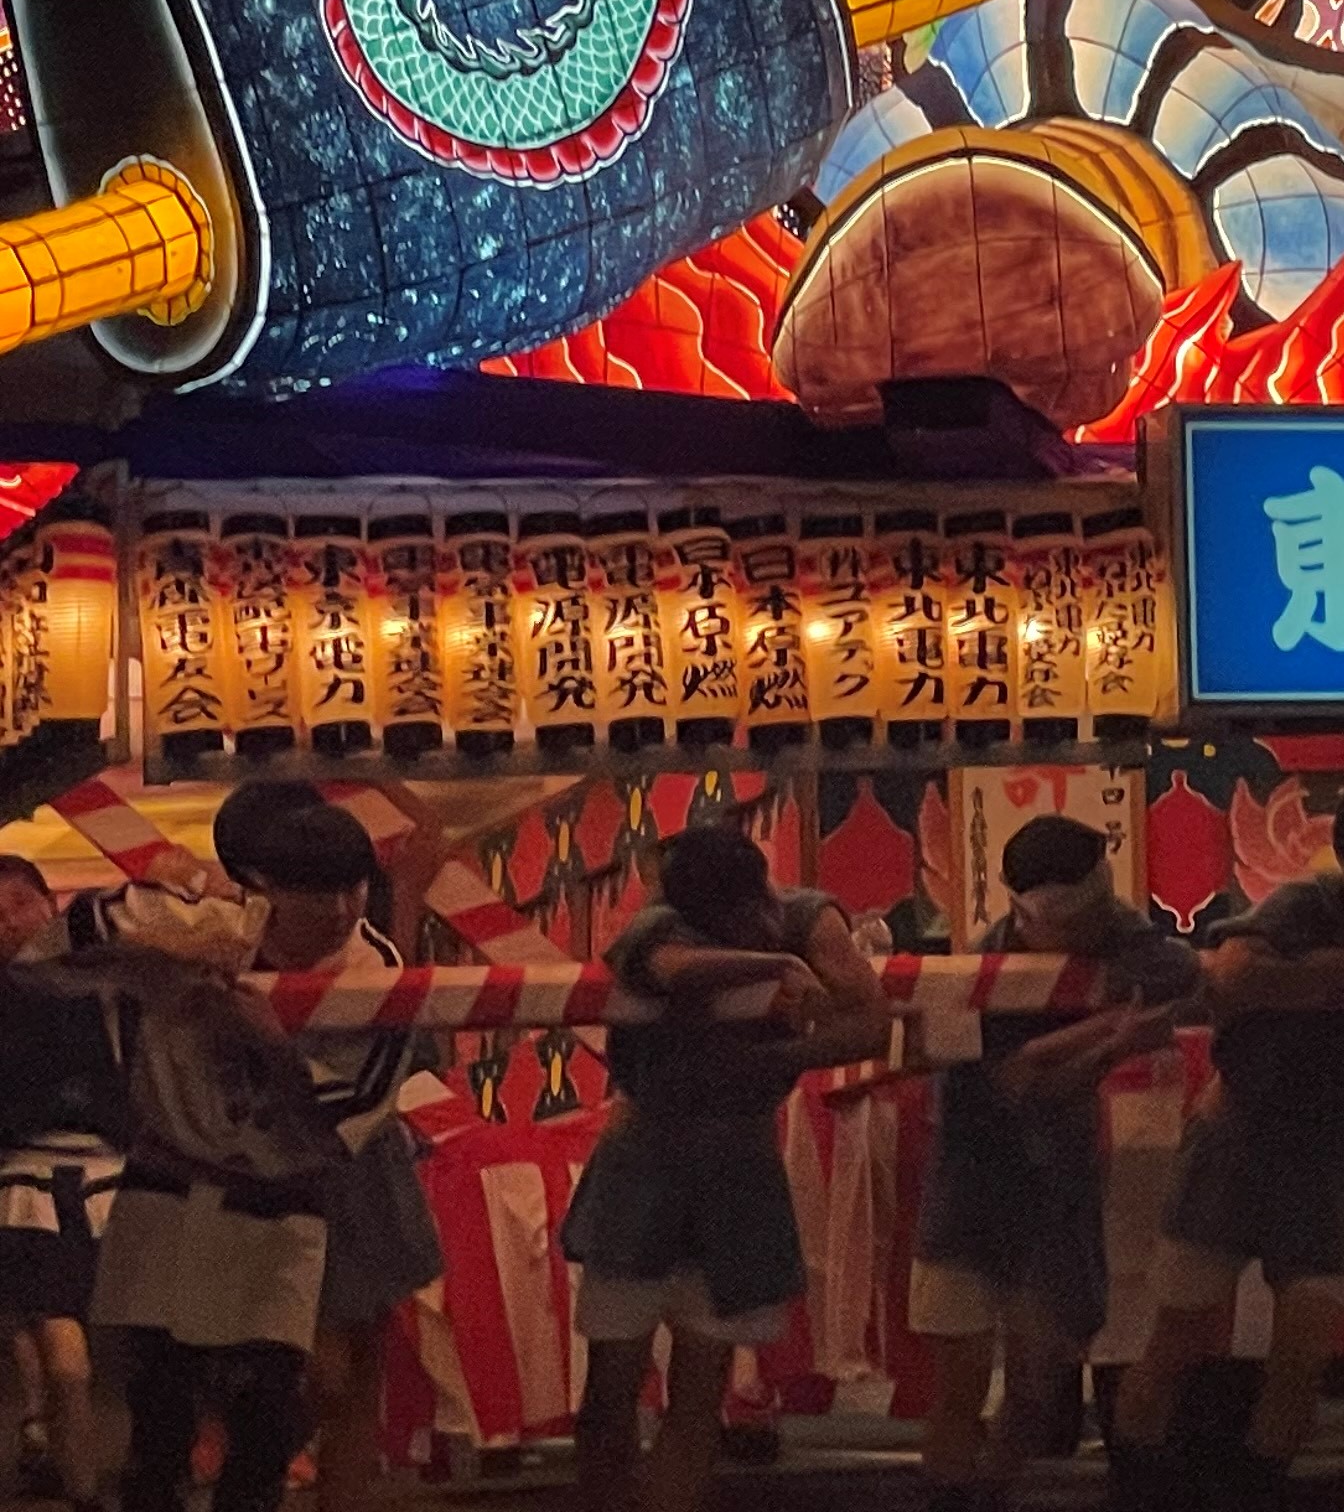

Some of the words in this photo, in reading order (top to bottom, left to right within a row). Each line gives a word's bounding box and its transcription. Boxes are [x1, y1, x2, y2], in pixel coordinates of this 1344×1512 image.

[532, 544, 597, 713] 電源開発
[600, 540, 668, 709] 電源開発
[673, 537, 738, 702] 日本原燃
[741, 543, 809, 715] 日本原燃
[886, 538, 945, 707] 東北電力
[951, 541, 1011, 707] 東北電力
